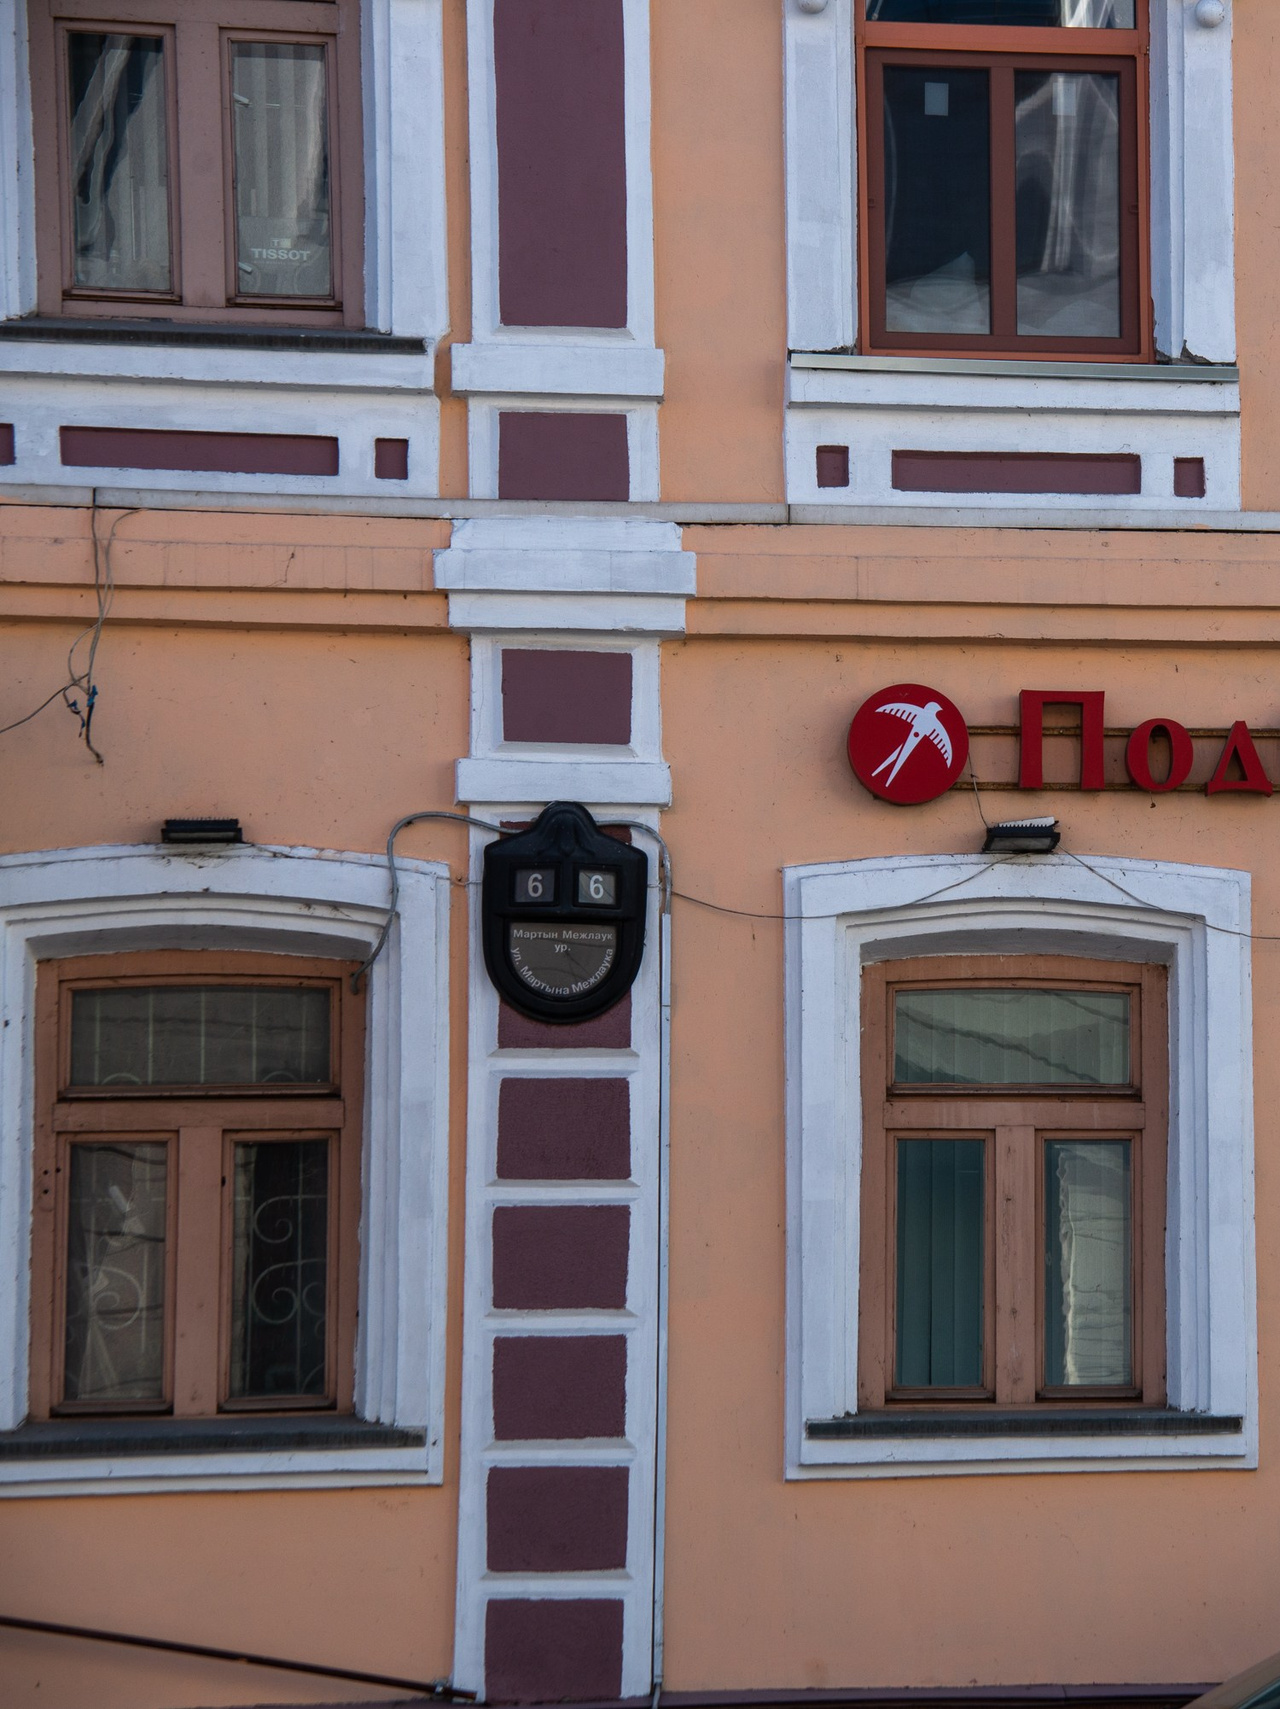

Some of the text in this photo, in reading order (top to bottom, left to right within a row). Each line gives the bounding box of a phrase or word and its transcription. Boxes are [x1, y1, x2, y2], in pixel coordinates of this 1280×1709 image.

[250, 248, 311, 261] TISSOT
[527, 873, 604, 899] 6 6
[513, 929, 613, 942] Мартын Межлаук
[554, 943, 571, 953] ур.
[511, 947, 614, 995] ул. Мартына Межлаука
